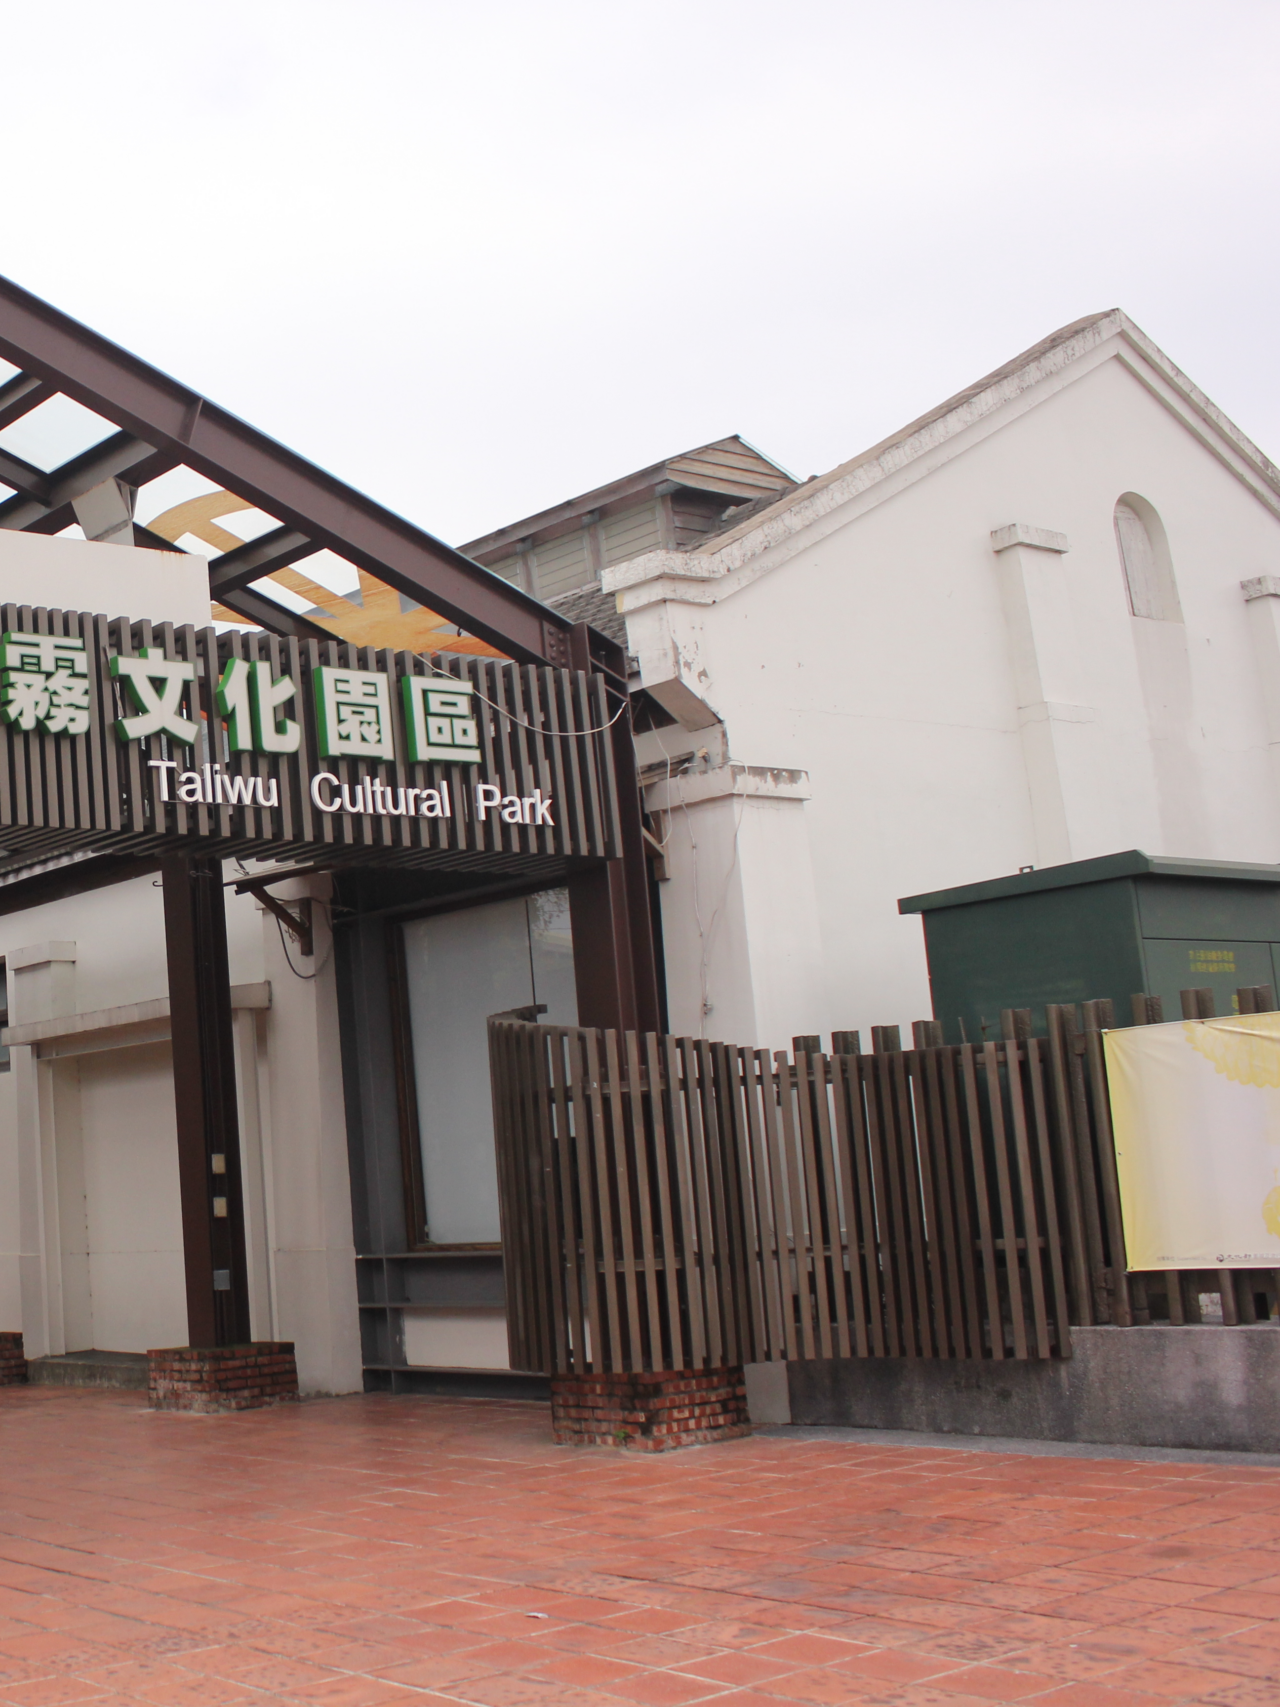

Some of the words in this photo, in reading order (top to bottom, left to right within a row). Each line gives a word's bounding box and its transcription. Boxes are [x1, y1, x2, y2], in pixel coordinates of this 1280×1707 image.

[147, 759, 279, 809] Taliwu
[310, 771, 453, 820] Cultural
[475, 782, 556, 827] Park
